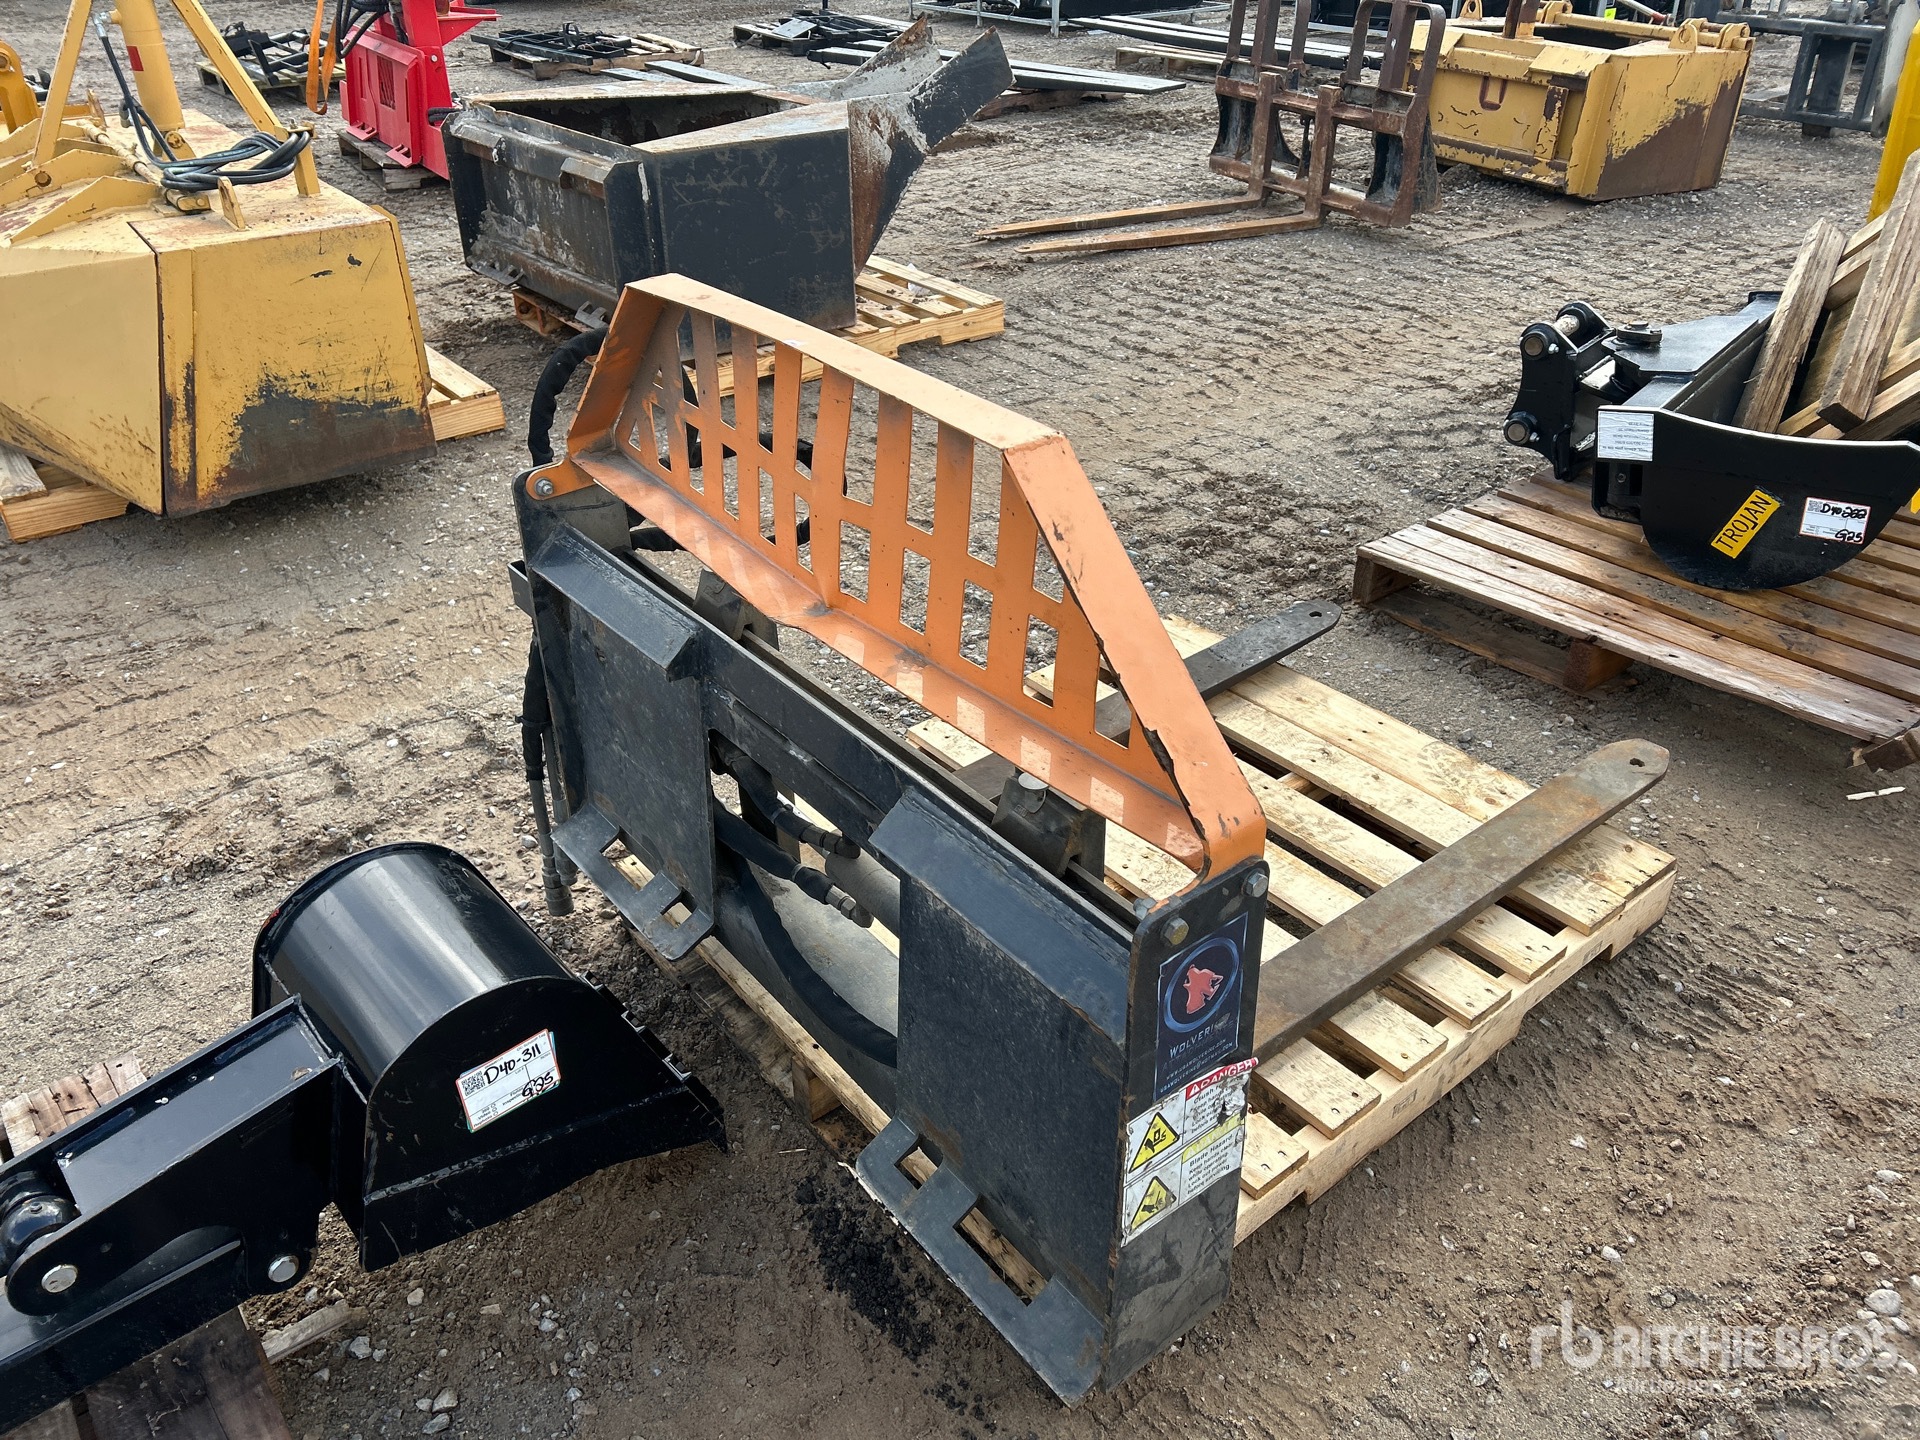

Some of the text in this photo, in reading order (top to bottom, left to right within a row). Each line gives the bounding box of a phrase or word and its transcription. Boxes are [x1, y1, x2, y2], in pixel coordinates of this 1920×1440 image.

[1715, 495, 1772, 550] TROJAN
[1835, 528, 1863, 542] G25
[1169, 1013, 1231, 1058] WOLVERI
[483, 1043, 541, 1084] D40-311
[1200, 1059, 1253, 1089] DANGER
[1189, 1151, 1208, 1167] Blade
[1210, 1134, 1233, 1153] Hazard
[1187, 1181, 1205, 1194] before
[1188, 1175, 1201, 1188] Lock
